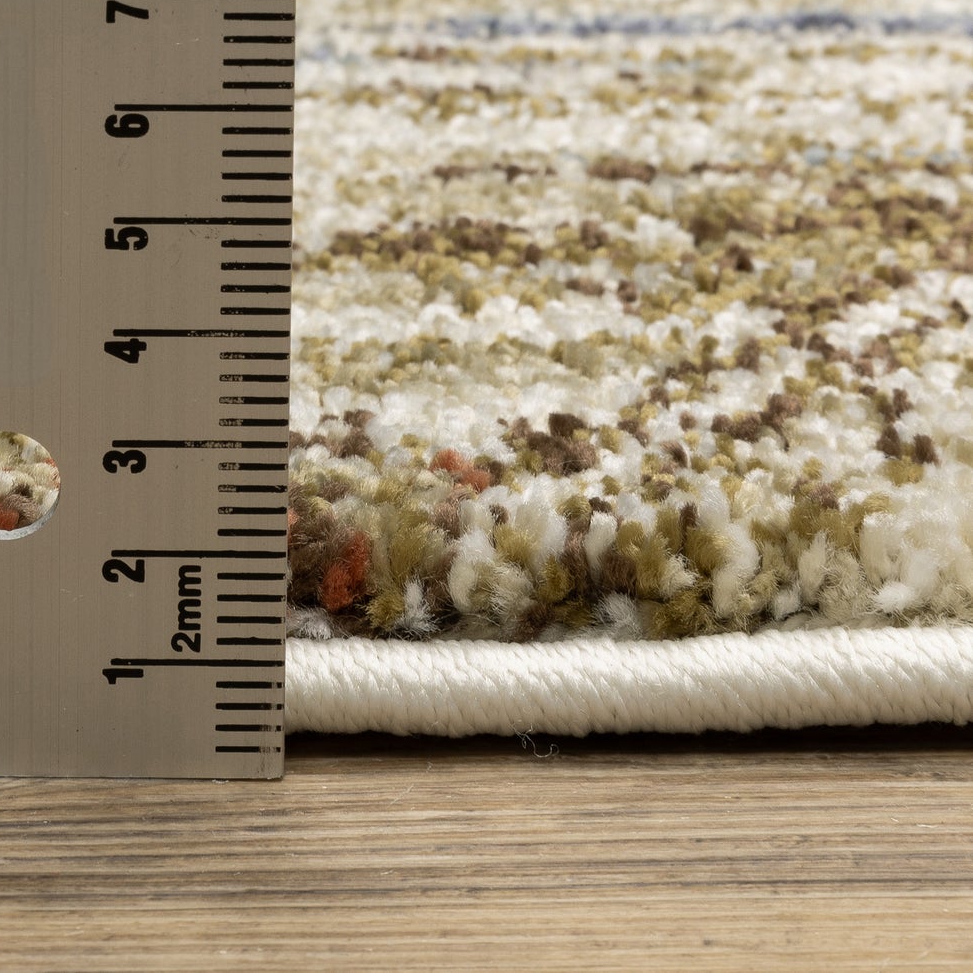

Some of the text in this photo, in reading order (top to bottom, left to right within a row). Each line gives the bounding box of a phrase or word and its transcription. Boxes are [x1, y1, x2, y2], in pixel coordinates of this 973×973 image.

[105, 0, 150, 24] 7
[104, 113, 150, 139] 6
[104, 226, 149, 252] 5
[103, 337, 148, 364] 4
[102, 449, 147, 474] 3
[101, 558, 146, 583] 2
[170, 564, 202, 653] 2mm
[101, 667, 145, 685] 1
